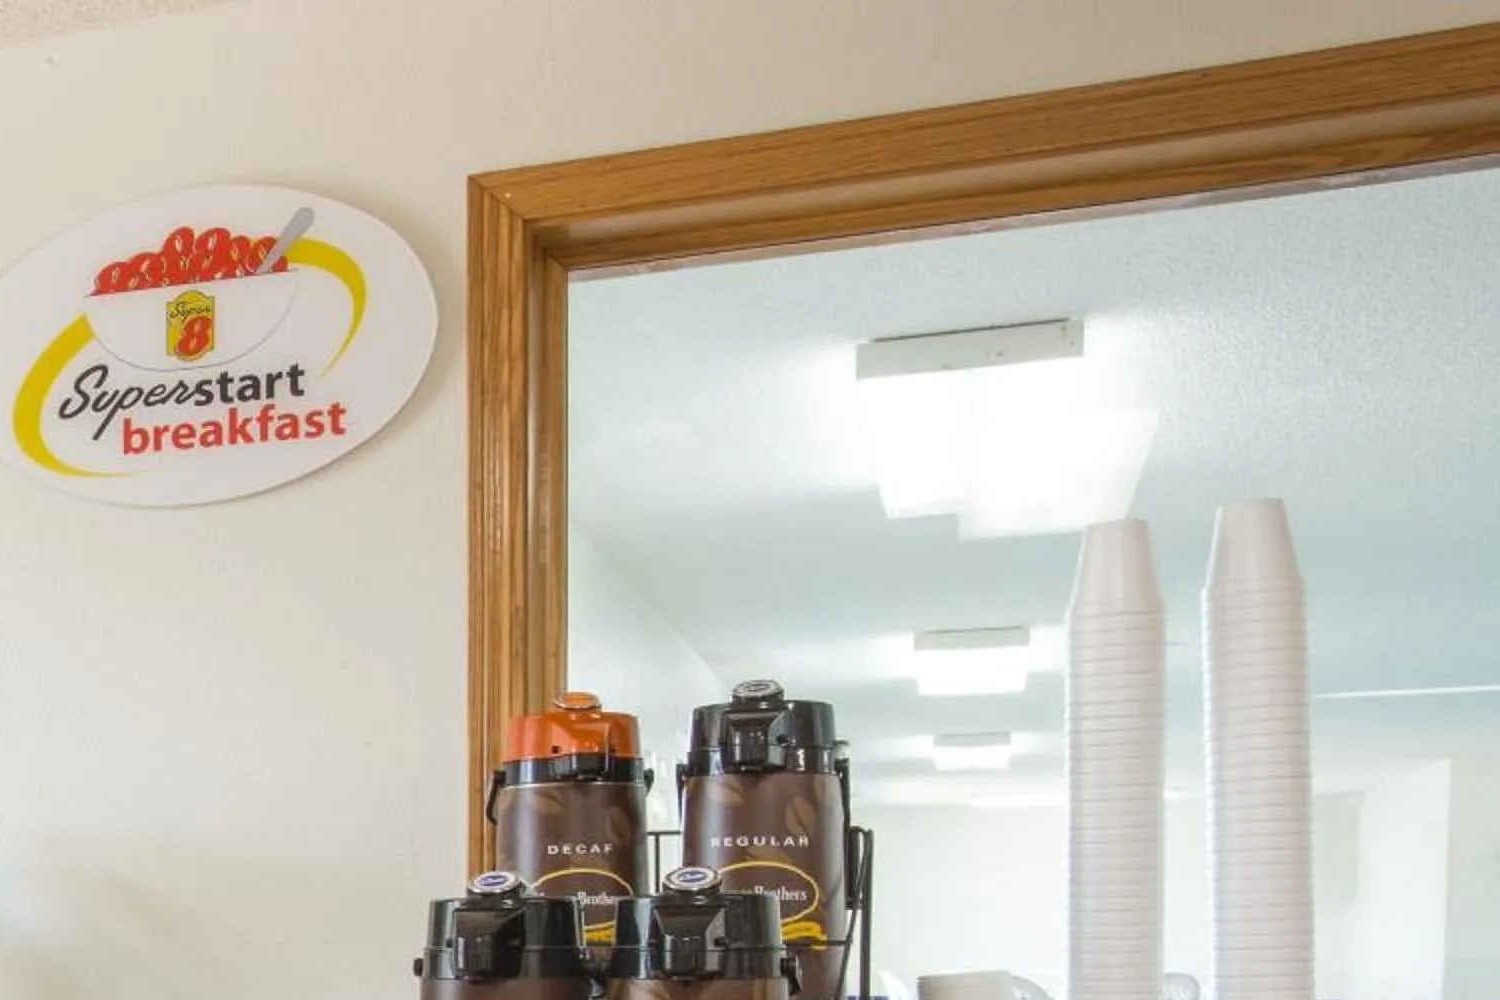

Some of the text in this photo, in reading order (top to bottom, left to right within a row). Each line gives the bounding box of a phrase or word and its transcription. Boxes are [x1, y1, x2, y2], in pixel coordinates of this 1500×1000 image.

[177, 315, 211, 357] 8
[122, 402, 347, 455] breakfast
[546, 843, 614, 855] DECAF
[710, 835, 810, 848] REGULAR
